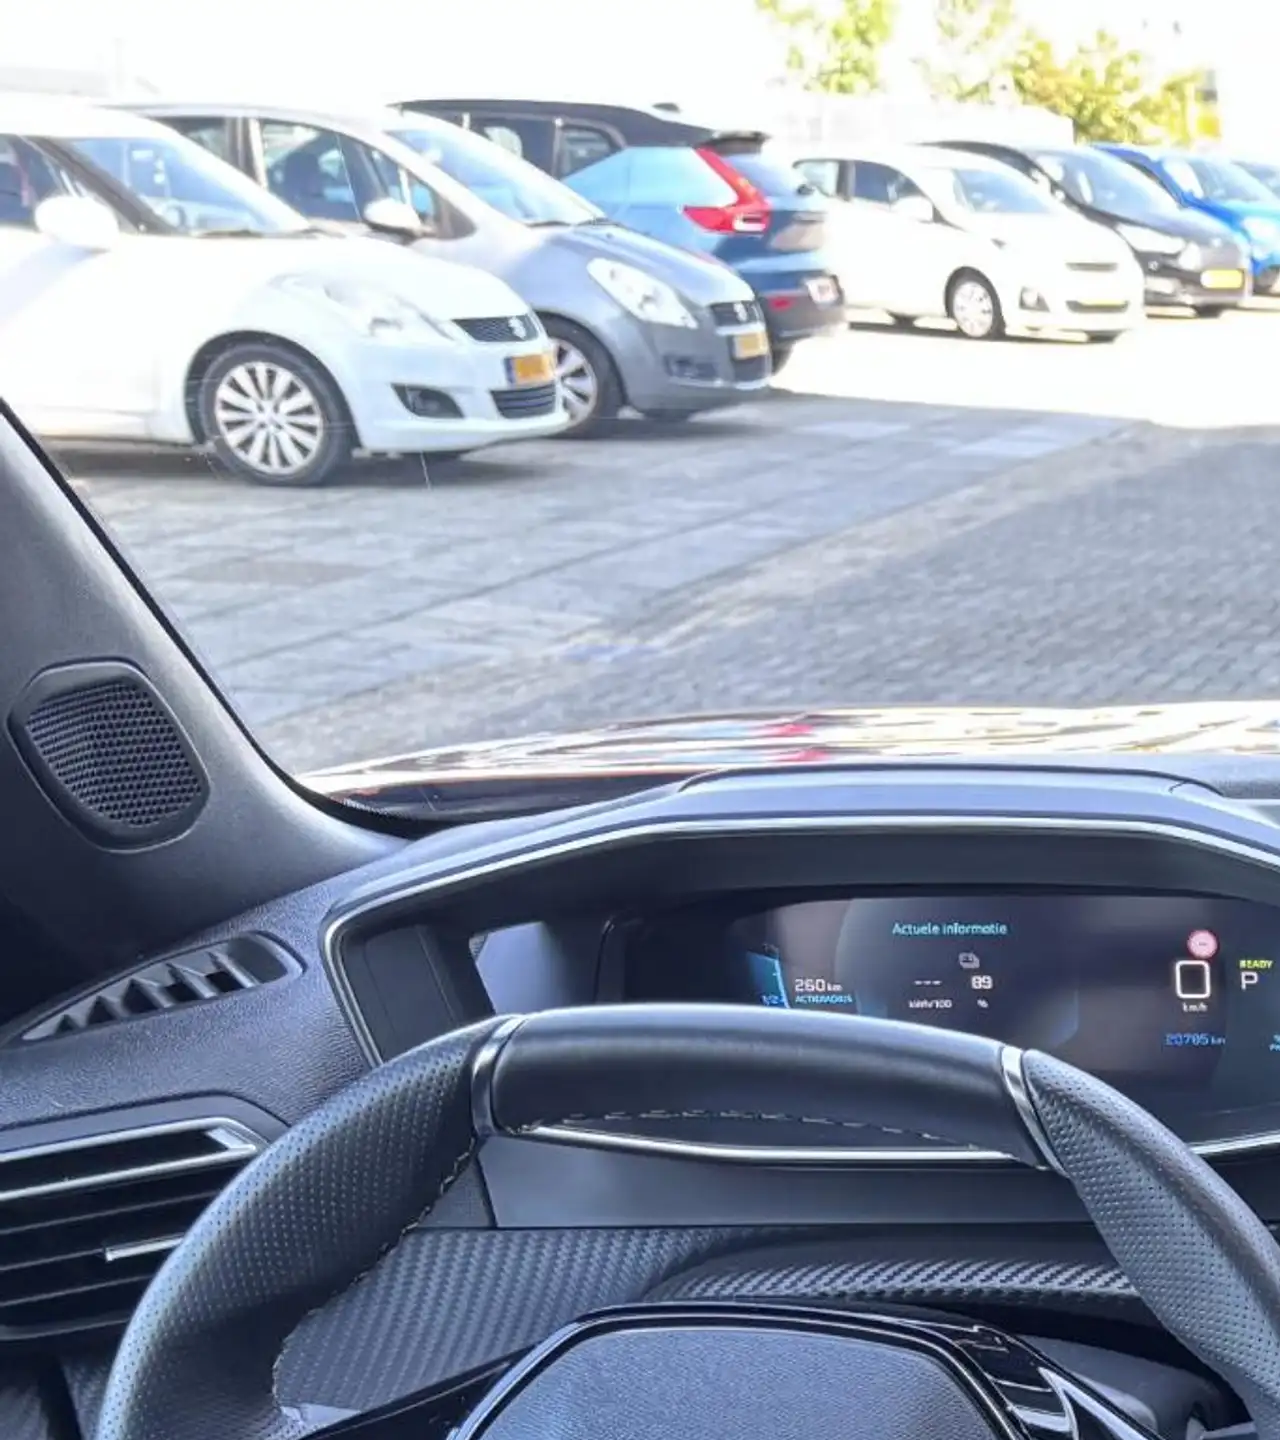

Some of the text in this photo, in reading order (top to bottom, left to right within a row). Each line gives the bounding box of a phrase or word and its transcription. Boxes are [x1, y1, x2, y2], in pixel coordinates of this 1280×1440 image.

[891, 921, 1007, 936] Actuele informatie
[1239, 959, 1273, 969] READY
[794, 978, 826, 993] 260
[1240, 971, 1258, 990] P
[1182, 1003, 1208, 1013] km/h
